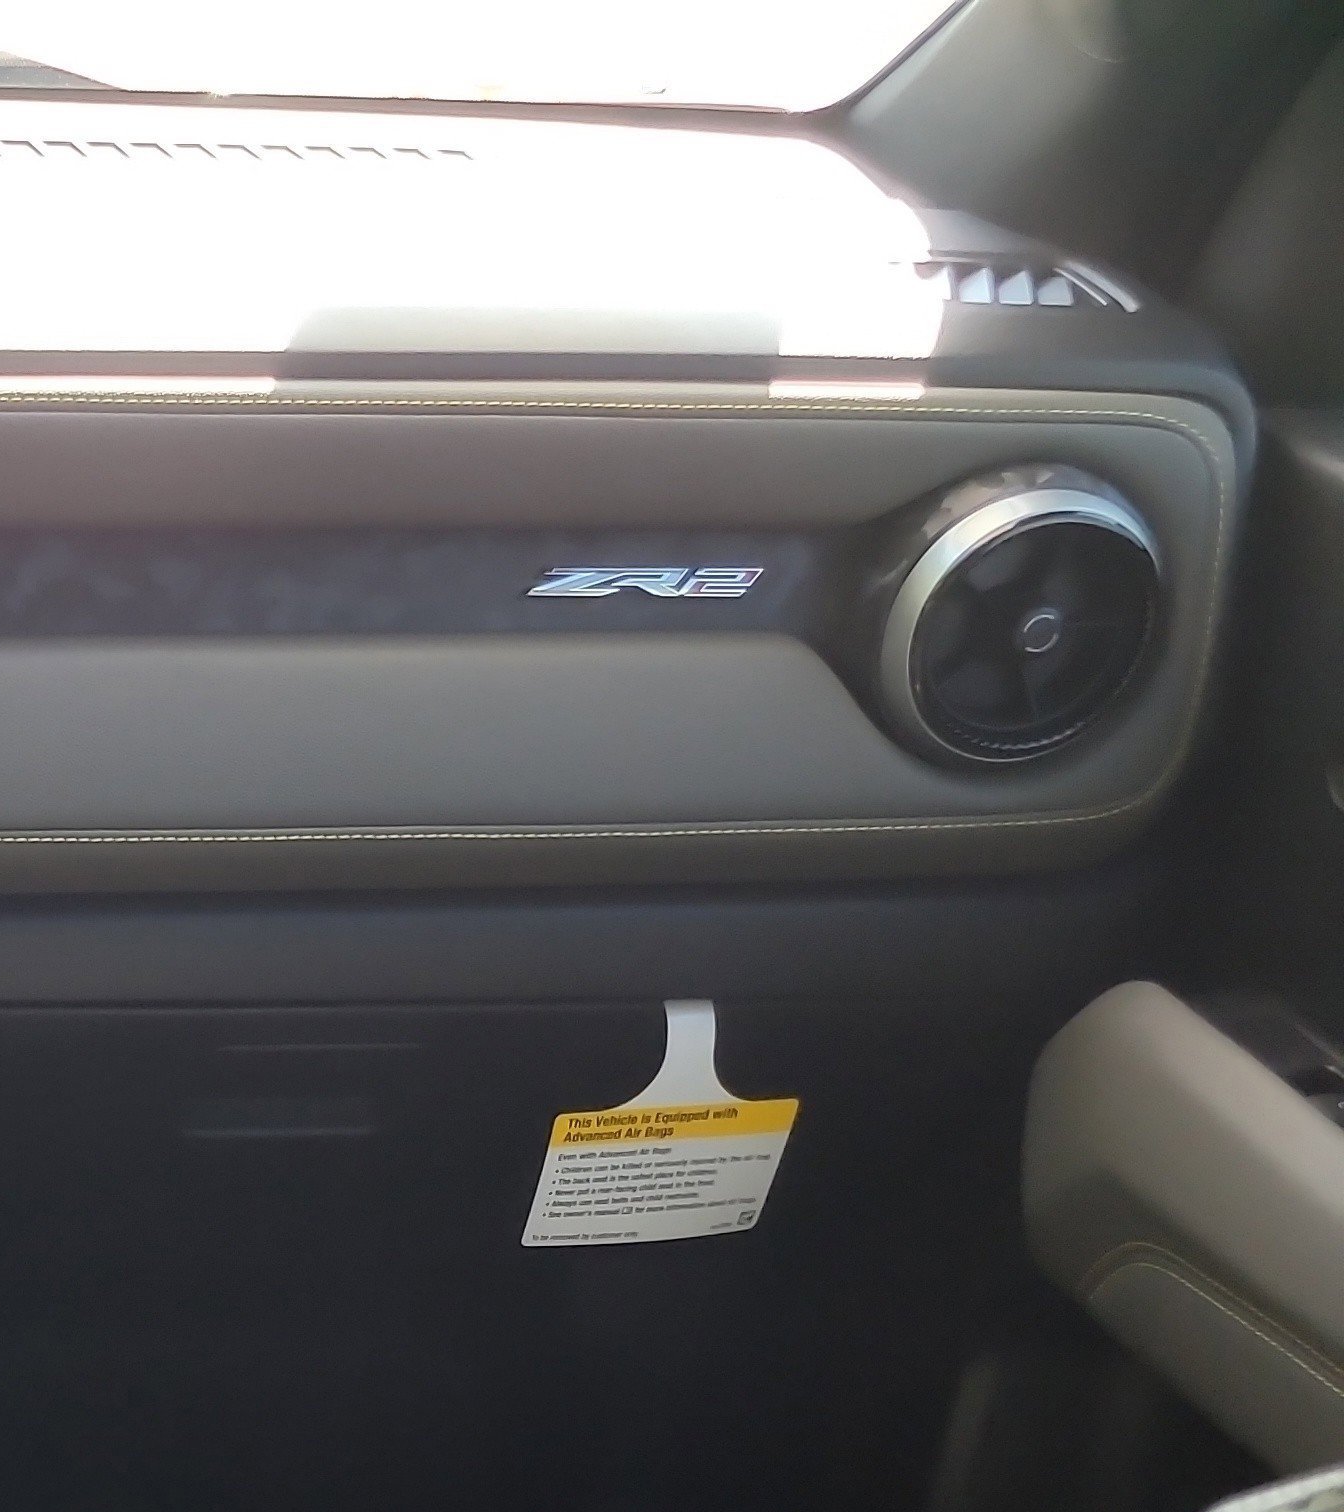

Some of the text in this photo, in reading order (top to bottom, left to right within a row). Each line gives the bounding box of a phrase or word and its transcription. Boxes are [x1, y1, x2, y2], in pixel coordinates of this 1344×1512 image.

[525, 567, 764, 597] ZR2
[568, 1118, 592, 1129] This
[596, 1114, 638, 1127] Vehicle
[654, 1109, 710, 1124] Equipped
[713, 1107, 739, 1120] with
[563, 1126, 674, 1143] Advanced Air Bags
